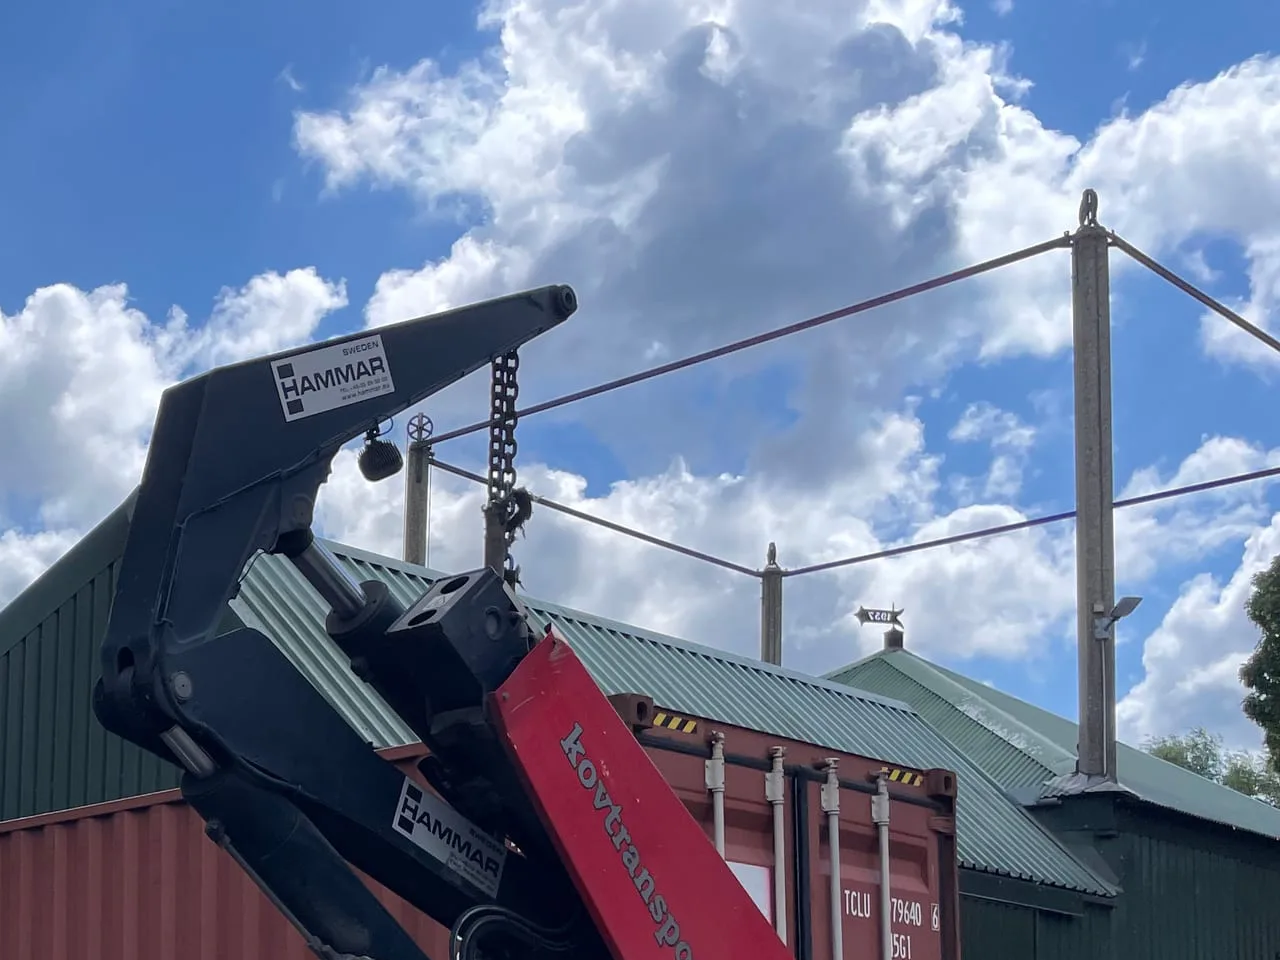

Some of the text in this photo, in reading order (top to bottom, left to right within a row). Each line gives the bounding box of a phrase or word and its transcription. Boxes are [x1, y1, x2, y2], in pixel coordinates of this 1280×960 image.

[343, 342, 379, 356] SWEDEN
[280, 356, 386, 400] HAMMAR
[401, 796, 501, 879] HAMMAR
[844, 889, 940, 929] TCLU 79640 6
